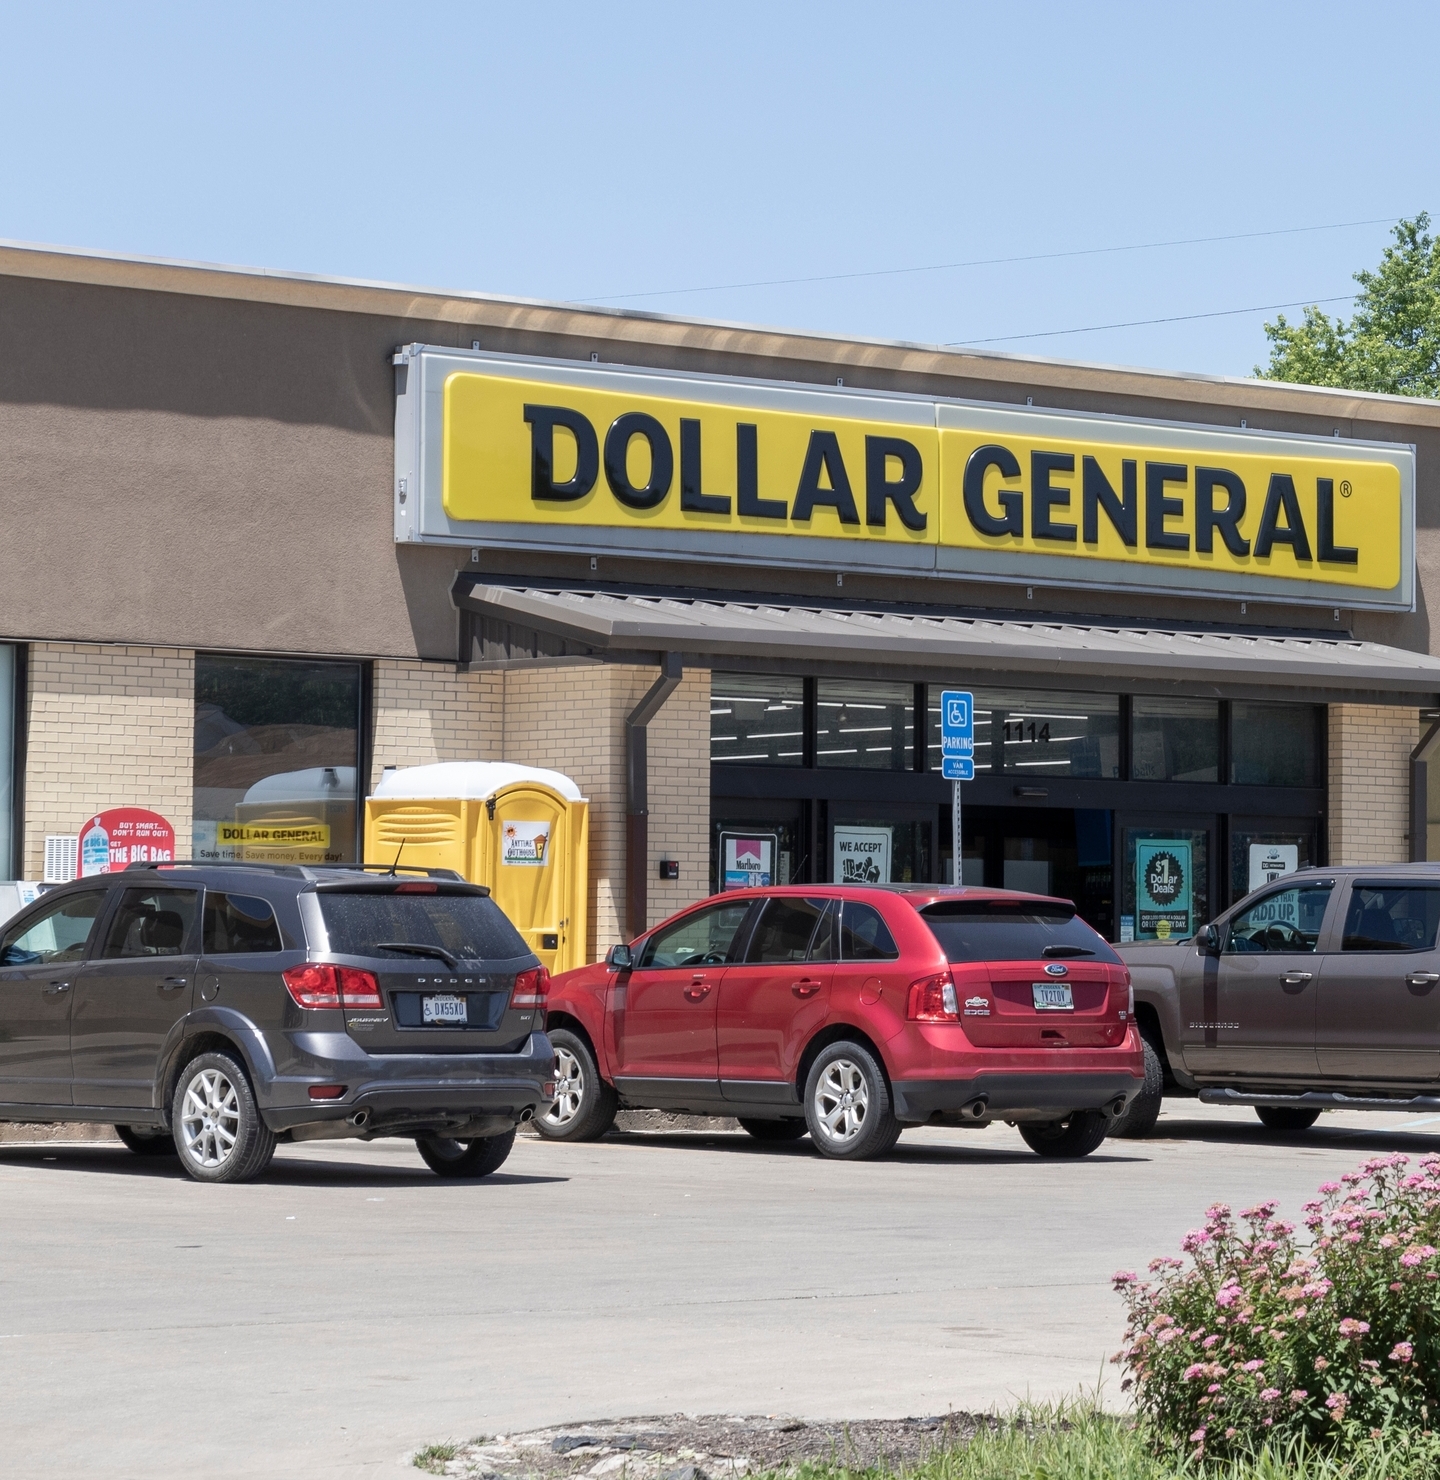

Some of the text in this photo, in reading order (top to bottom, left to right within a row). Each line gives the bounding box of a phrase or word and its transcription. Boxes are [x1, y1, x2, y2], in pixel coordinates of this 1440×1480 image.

[523, 403, 1359, 565] DOLLAR GENERAL
[1002, 722, 1051, 743] 1114
[943, 736, 972, 750] PARKING
[223, 828, 324, 842] DOLLAR GENERAL
[109, 846, 128, 863] THE
[131, 845, 148, 862] BIG
[150, 846, 171, 862] BAG
[839, 841, 882, 853] WE ACCEPT
[200, 850, 343, 862] Save time. Save money. Every day!
[736, 858, 761, 870] Marlboro
[1153, 884, 1174, 893] Deals
[1252, 904, 1295, 921] ADD UP.
